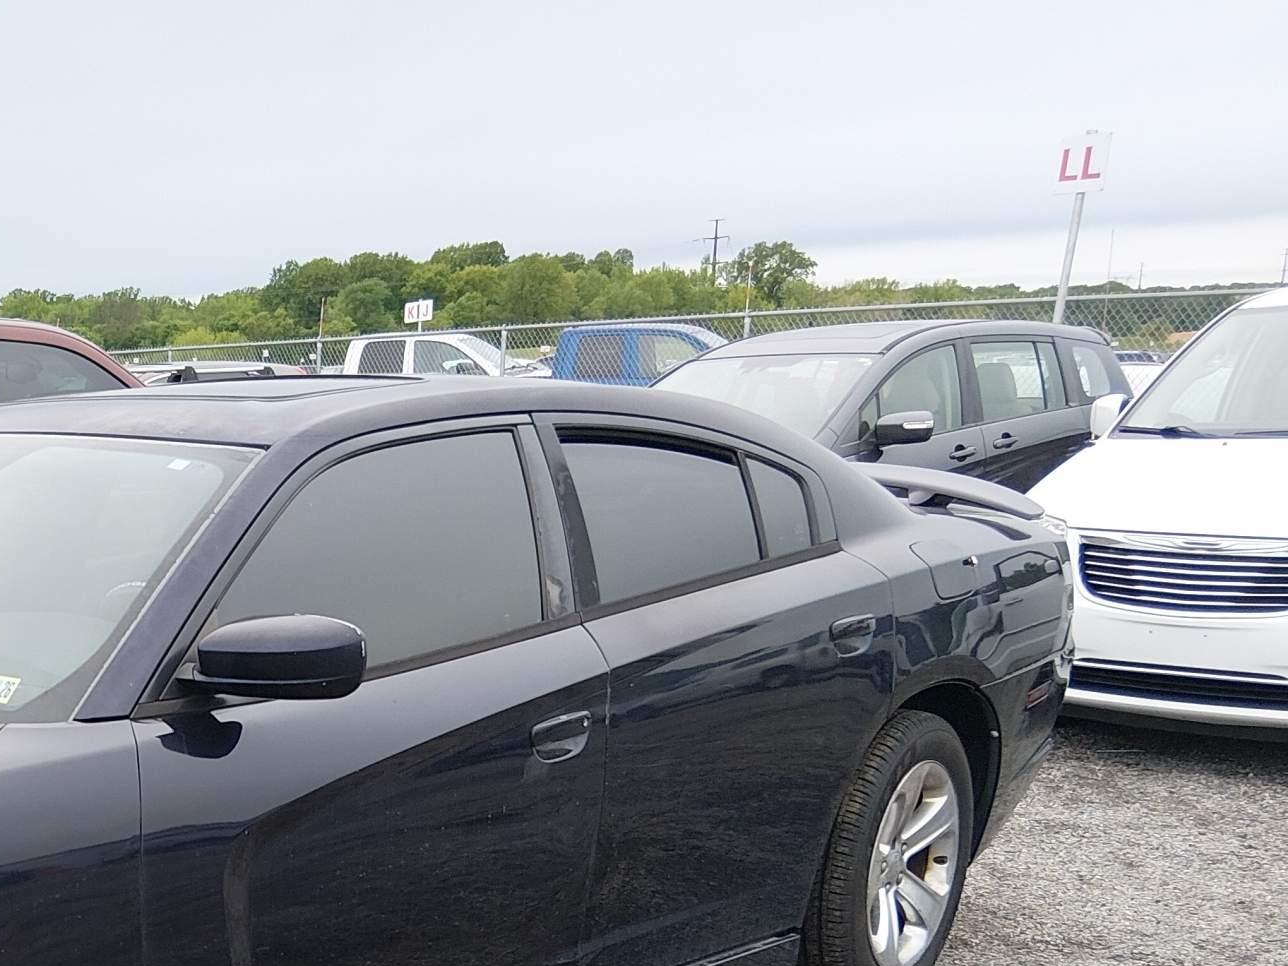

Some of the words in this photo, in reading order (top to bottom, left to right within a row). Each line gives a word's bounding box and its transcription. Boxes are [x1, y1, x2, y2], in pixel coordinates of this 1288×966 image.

[1058, 146, 1101, 182] LL
[407, 305, 415, 320] K
[422, 303, 429, 317] J
